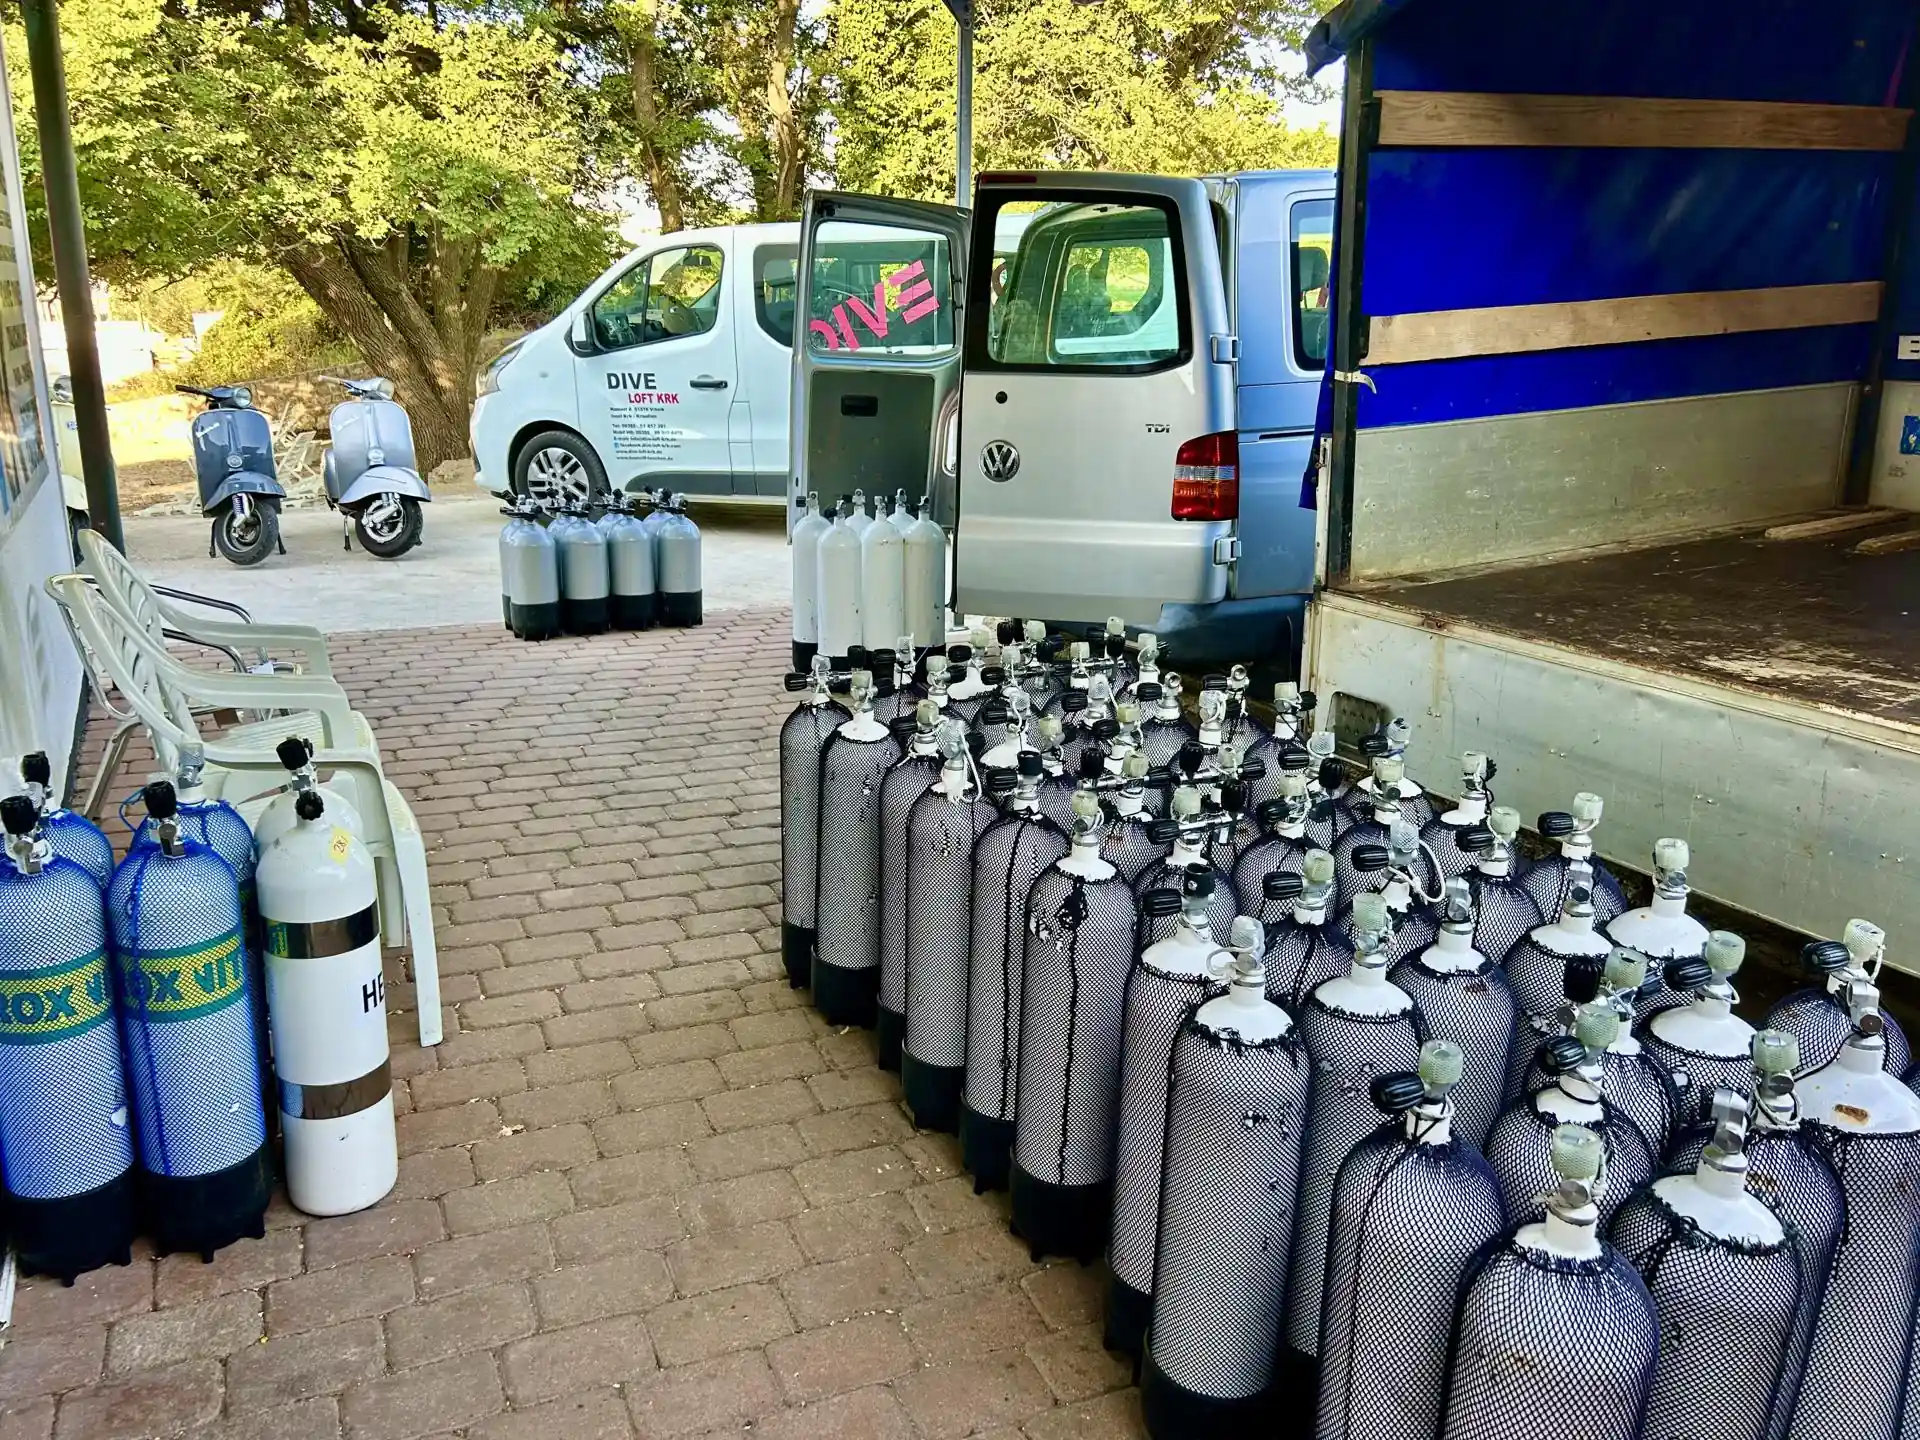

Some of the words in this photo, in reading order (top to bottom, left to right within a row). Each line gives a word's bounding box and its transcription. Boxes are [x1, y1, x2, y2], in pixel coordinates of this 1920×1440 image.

[606, 372, 657, 390] DIVE
[628, 393, 653, 404] LOFT
[656, 393, 679, 404] KRK
[1145, 423, 1171, 433] TDI
